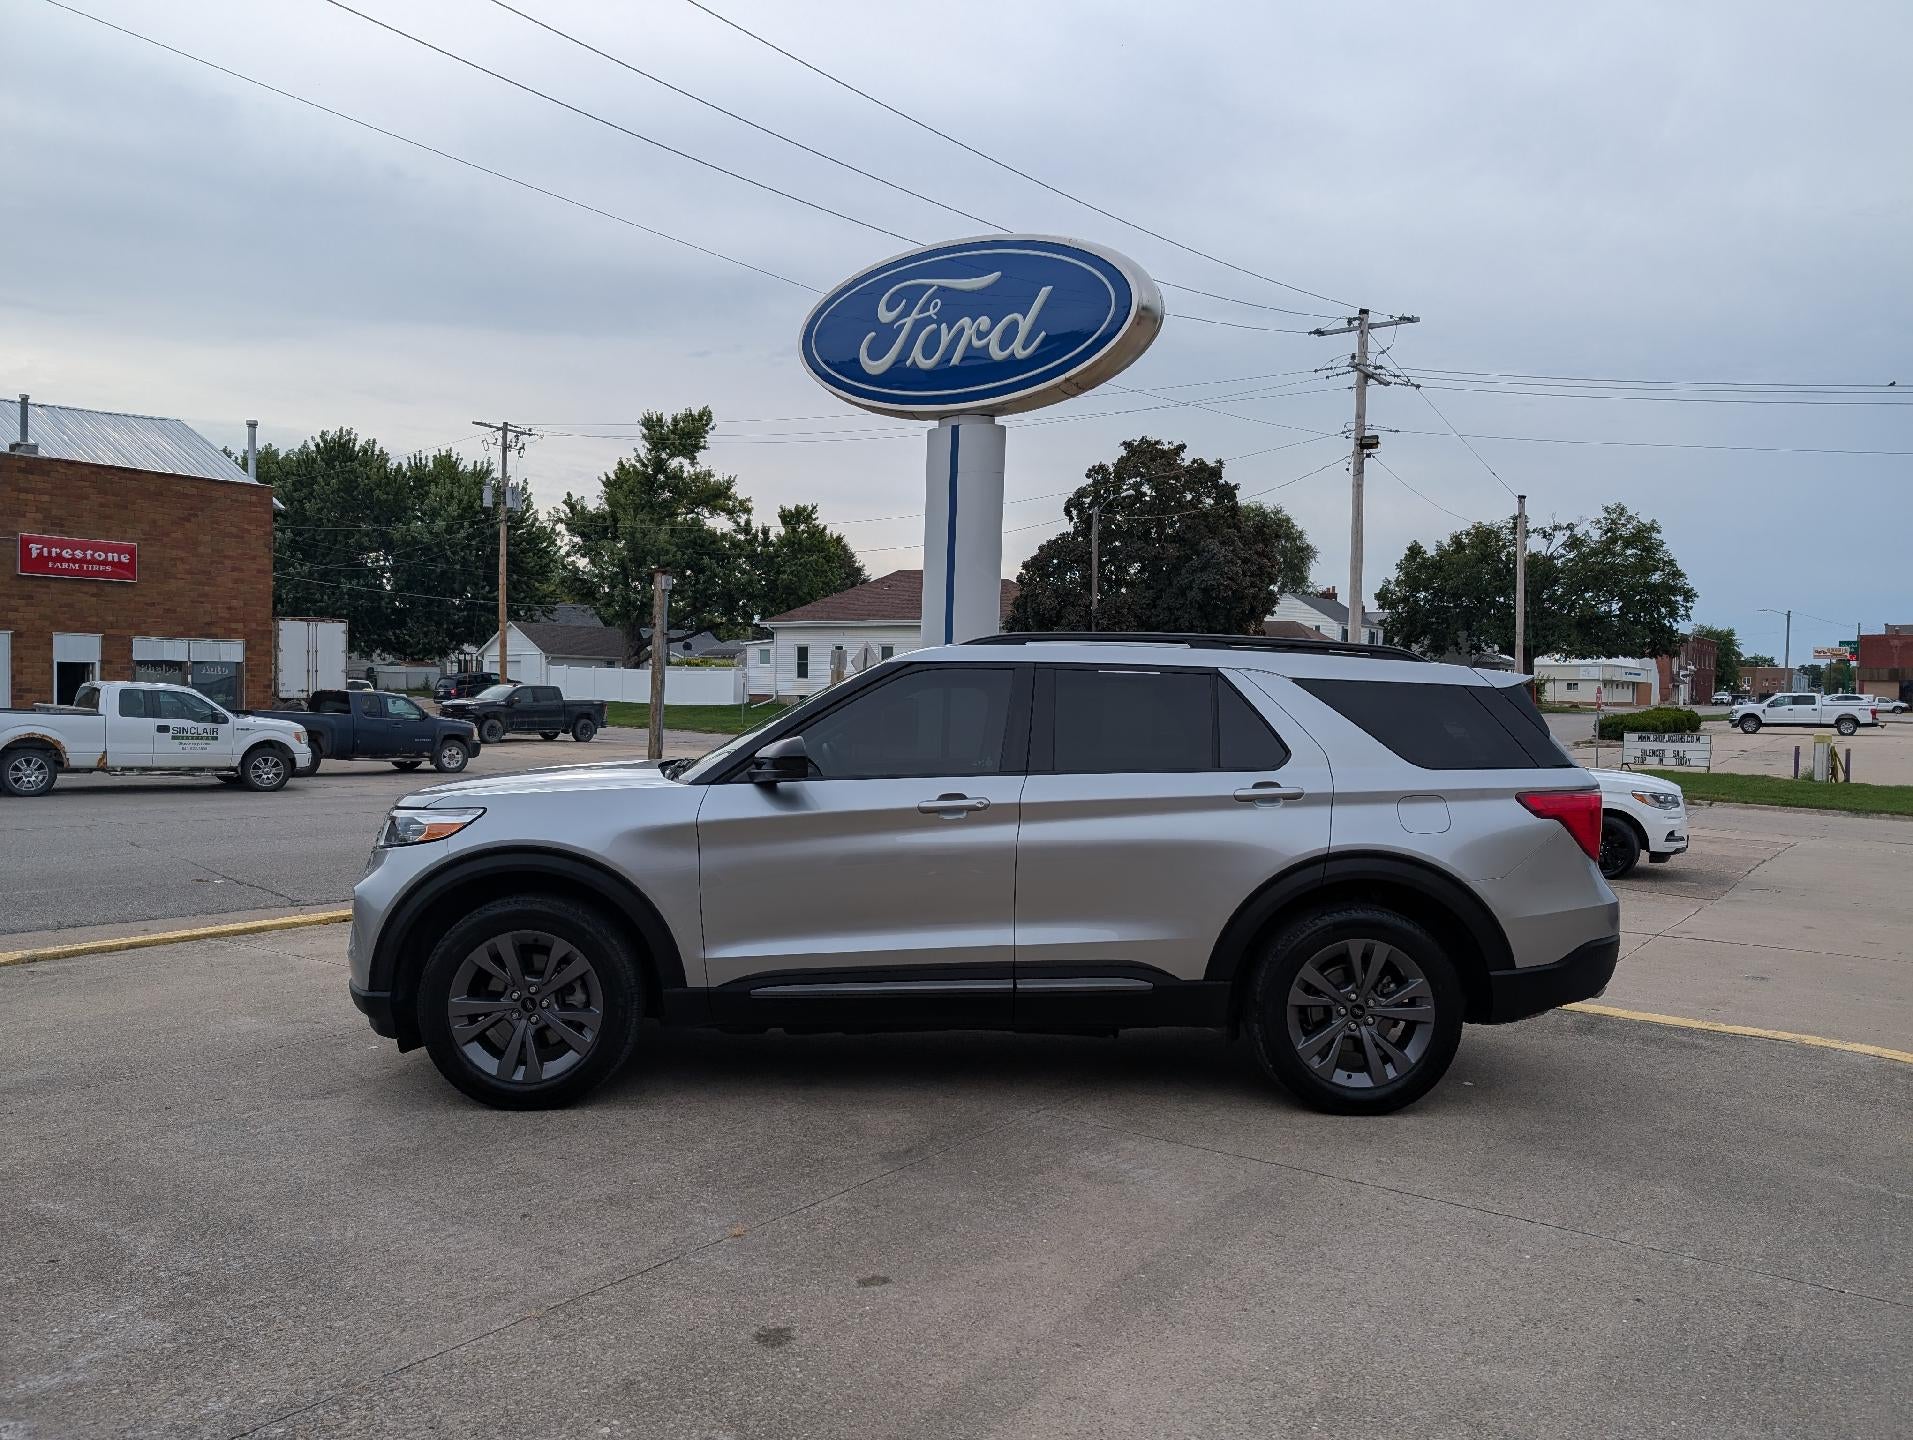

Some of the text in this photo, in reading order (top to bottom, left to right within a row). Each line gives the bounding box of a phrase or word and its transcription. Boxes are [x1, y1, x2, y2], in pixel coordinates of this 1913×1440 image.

[859, 271, 1053, 375] Ford
[28, 543, 131, 563] Firestone
[48, 561, 113, 572] FARM TIRES
[171, 726, 219, 736] SINCLAIR
[1641, 748, 1687, 759] SILENCER SALE
[1633, 756, 1647, 765] STOP
[1675, 757, 1692, 767] TODAY
